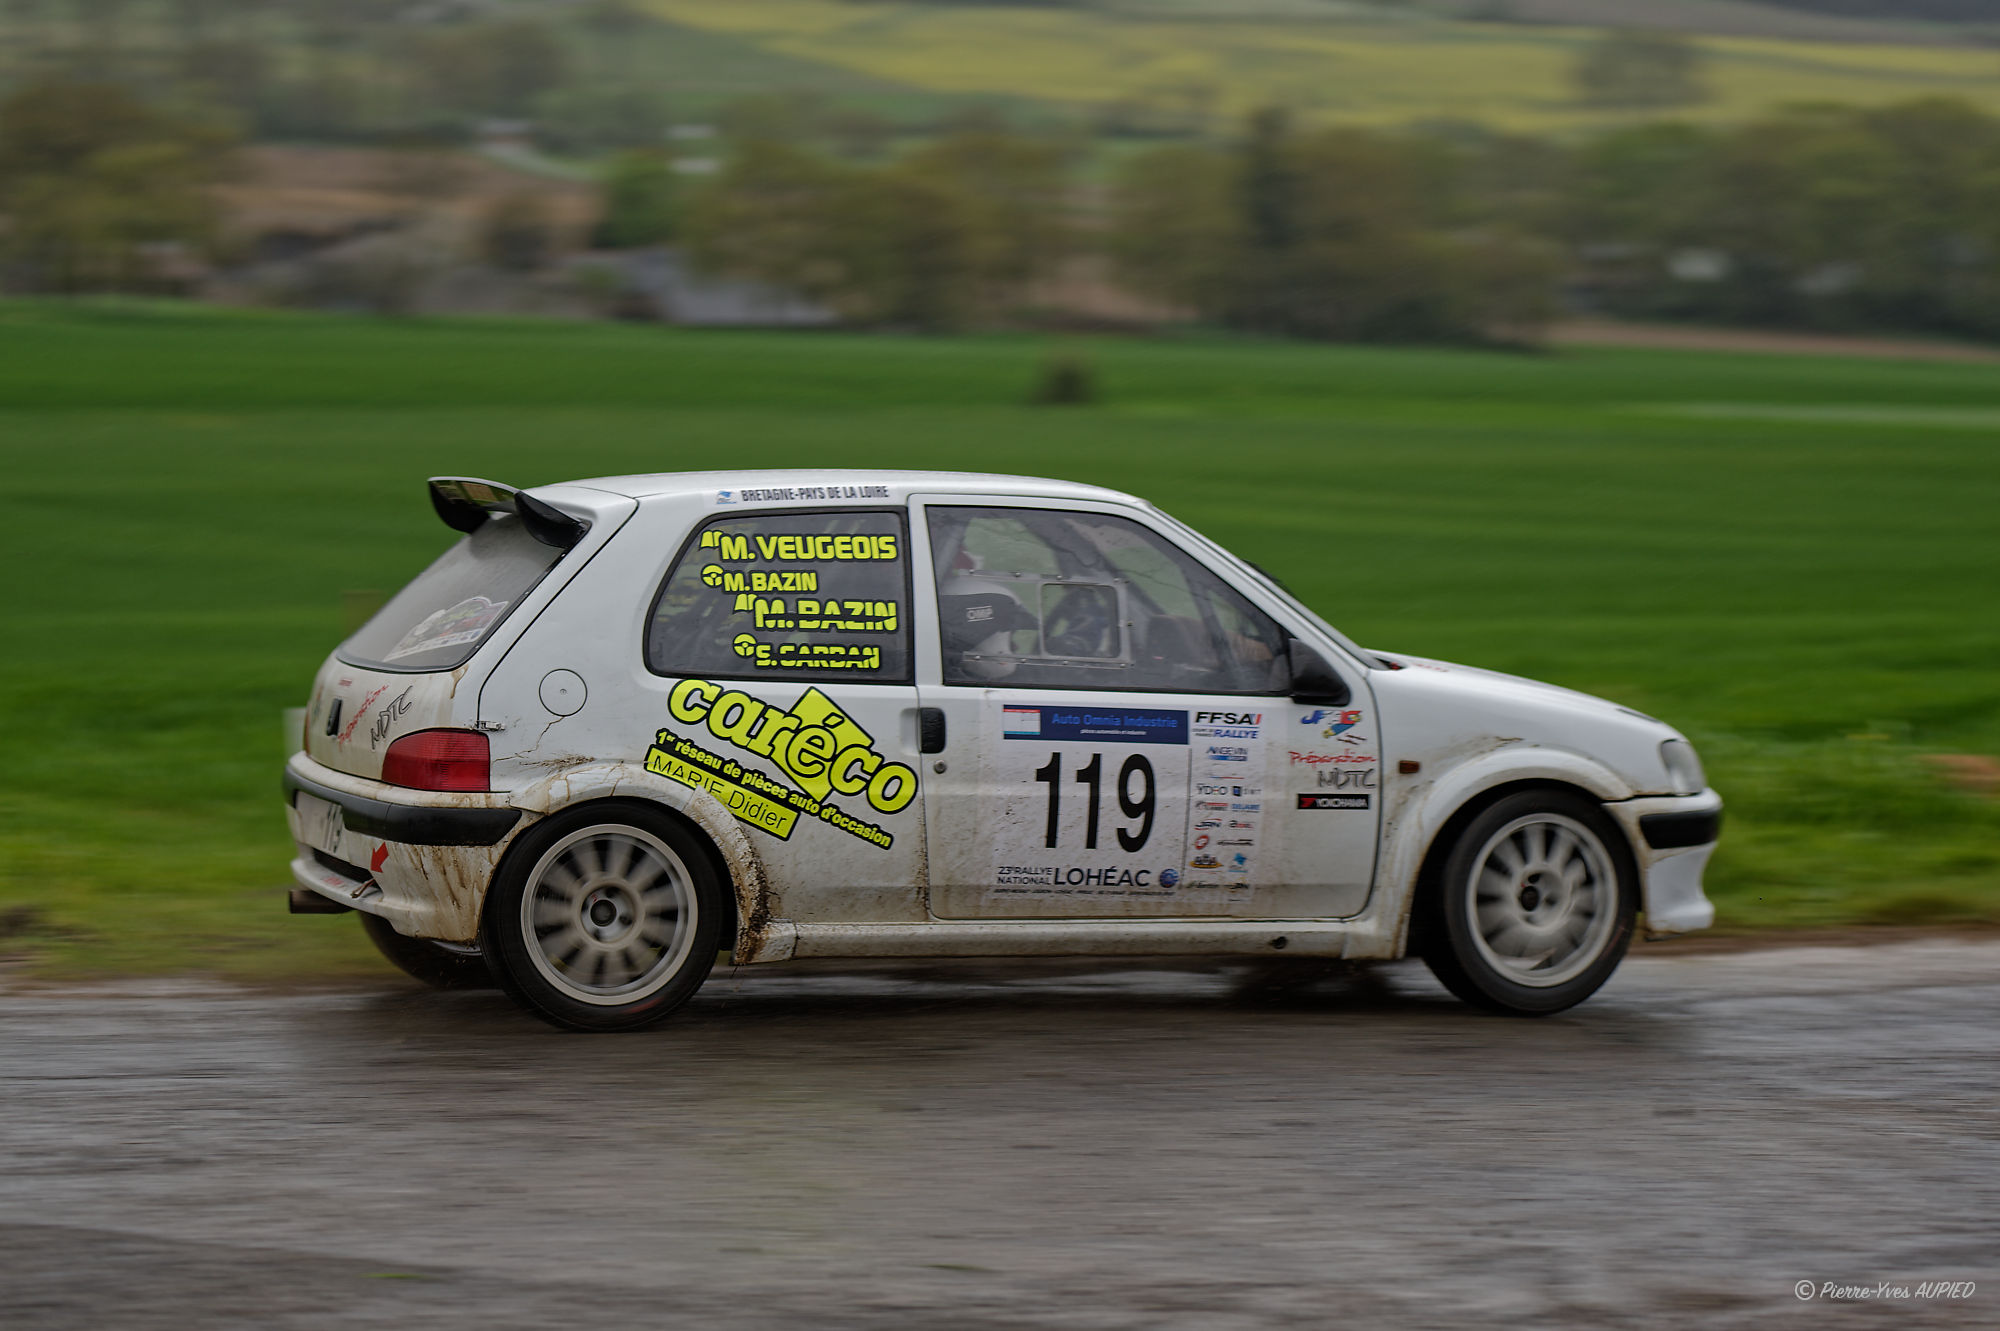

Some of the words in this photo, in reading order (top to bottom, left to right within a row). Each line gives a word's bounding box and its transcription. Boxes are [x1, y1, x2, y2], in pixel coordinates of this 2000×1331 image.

[741, 487, 825, 502] BRETAGNE-PAYS
[827, 486, 841, 499] DE
[843, 486, 857, 498] LA
[860, 485, 890, 498] LOIRE
[755, 535, 897, 560] VEUGEOIS
[798, 599, 898, 631] BAZIN
[1051, 713, 1081, 725] Auto
[1083, 714, 1121, 726] Omnia
[1124, 715, 1178, 728] Industrie
[1195, 711, 1253, 725] FFSA
[1213, 729, 1258, 739] RALLYE
[667, 678, 918, 814] caréco
[675, 741, 723, 770] réseau
[723, 762, 741, 778] de
[741, 772, 788, 799] pièces
[789, 793, 820, 816] auto
[728, 790, 788, 829] Didier
[1035, 751, 1156, 853] 119
[996, 876, 1052, 886] NATIONAL
[1054, 866, 1151, 887] LOHÉAC
[1015, 867, 1053, 876] RALLYE
